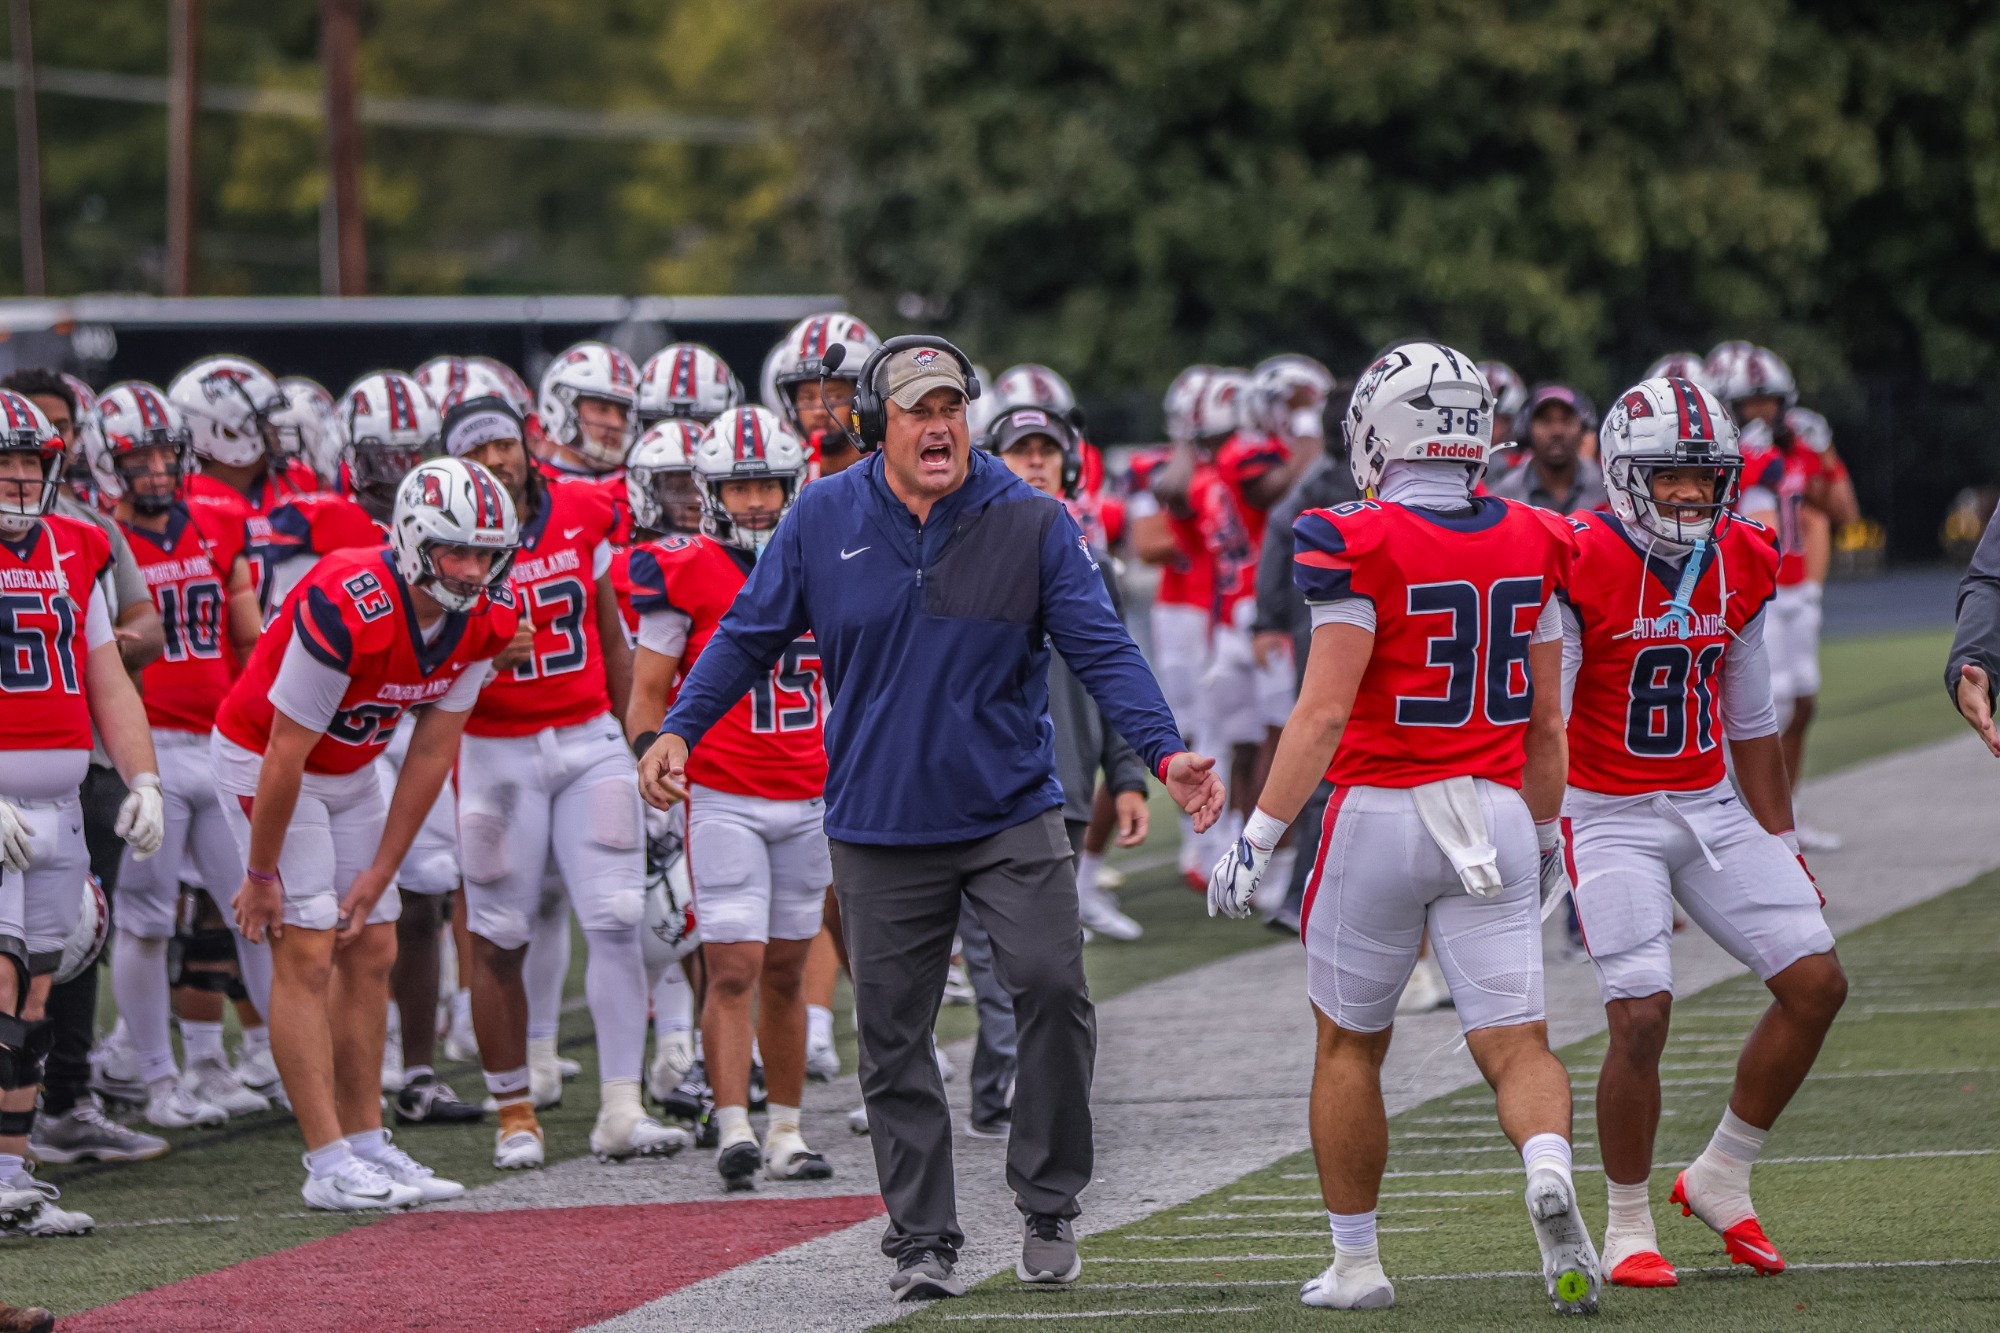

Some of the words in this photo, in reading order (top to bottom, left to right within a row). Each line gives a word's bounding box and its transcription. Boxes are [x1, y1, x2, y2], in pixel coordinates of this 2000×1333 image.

[1426, 442, 1484, 460] Riddell
[0, 568, 69, 590] MBERLANS
[157, 577, 226, 662] 10
[342, 570, 393, 623] 83
[0, 591, 80, 694] 61
[1395, 575, 1544, 728] 36
[1632, 614, 1725, 640] CUMBELANDS
[751, 638, 820, 733] 15
[1624, 643, 1725, 758] 81
